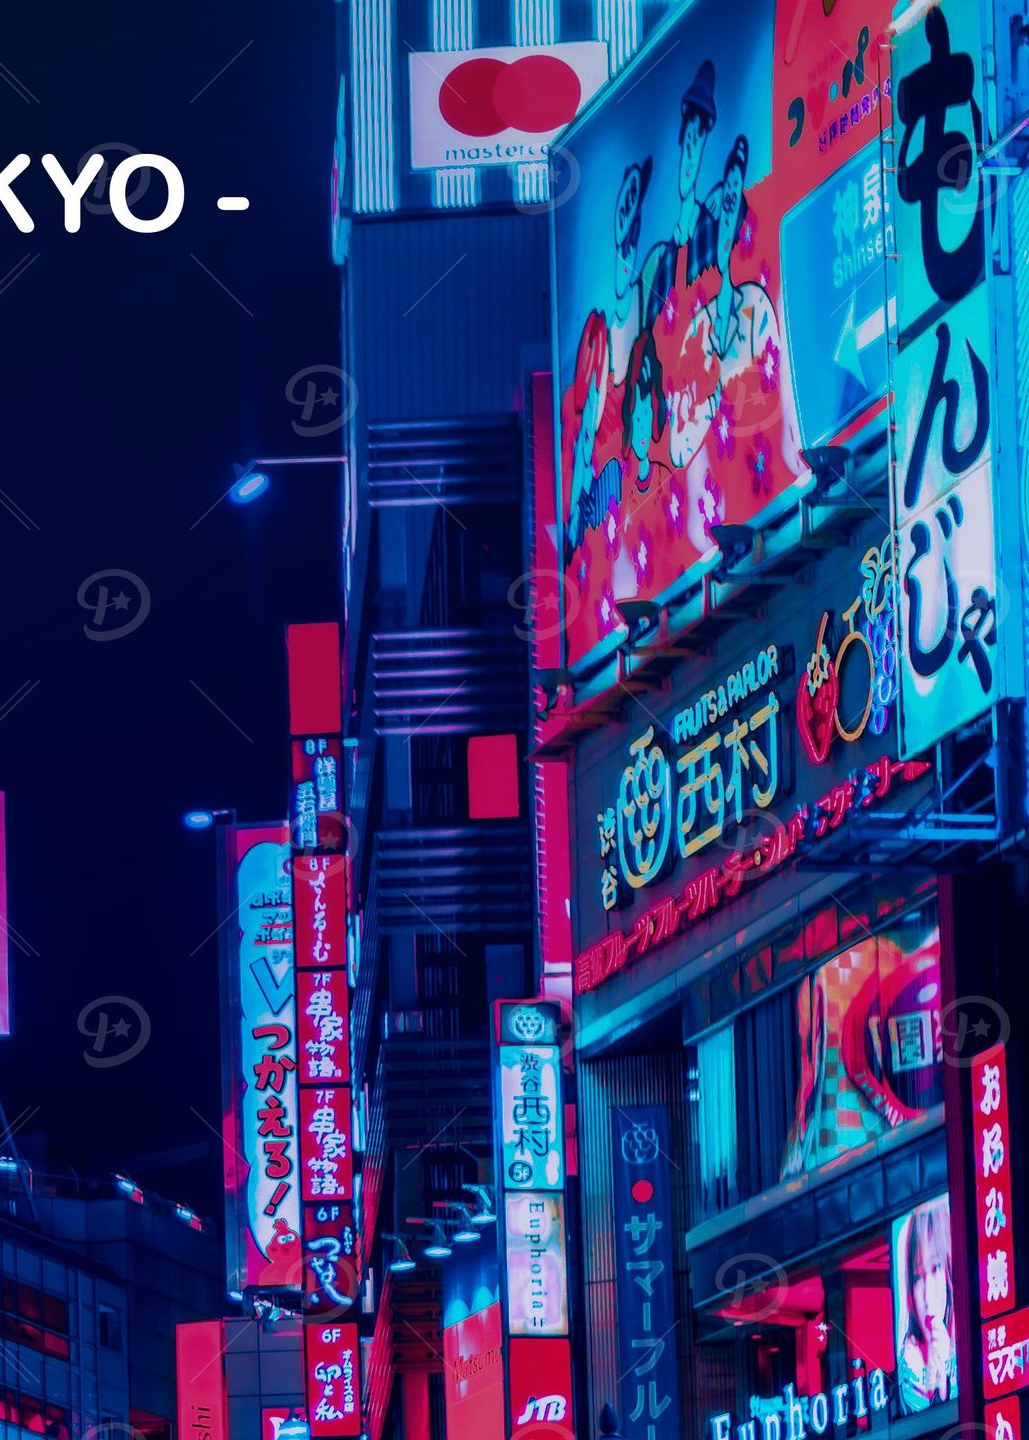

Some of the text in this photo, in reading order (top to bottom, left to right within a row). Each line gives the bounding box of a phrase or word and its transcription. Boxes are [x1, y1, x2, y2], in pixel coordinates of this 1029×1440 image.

[897, 6, 996, 694] もんじゃ
[677, 691, 780, 859] 西村
[309, 858, 331, 871] 8F
[313, 973, 332, 986] 7F
[315, 1090, 334, 1104] 7F
[317, 1206, 339, 1222] 6F
[525, 1201, 548, 1309] Euphoria
[322, 1328, 341, 1343] 6F
[517, 1394, 567, 1426] JTB
